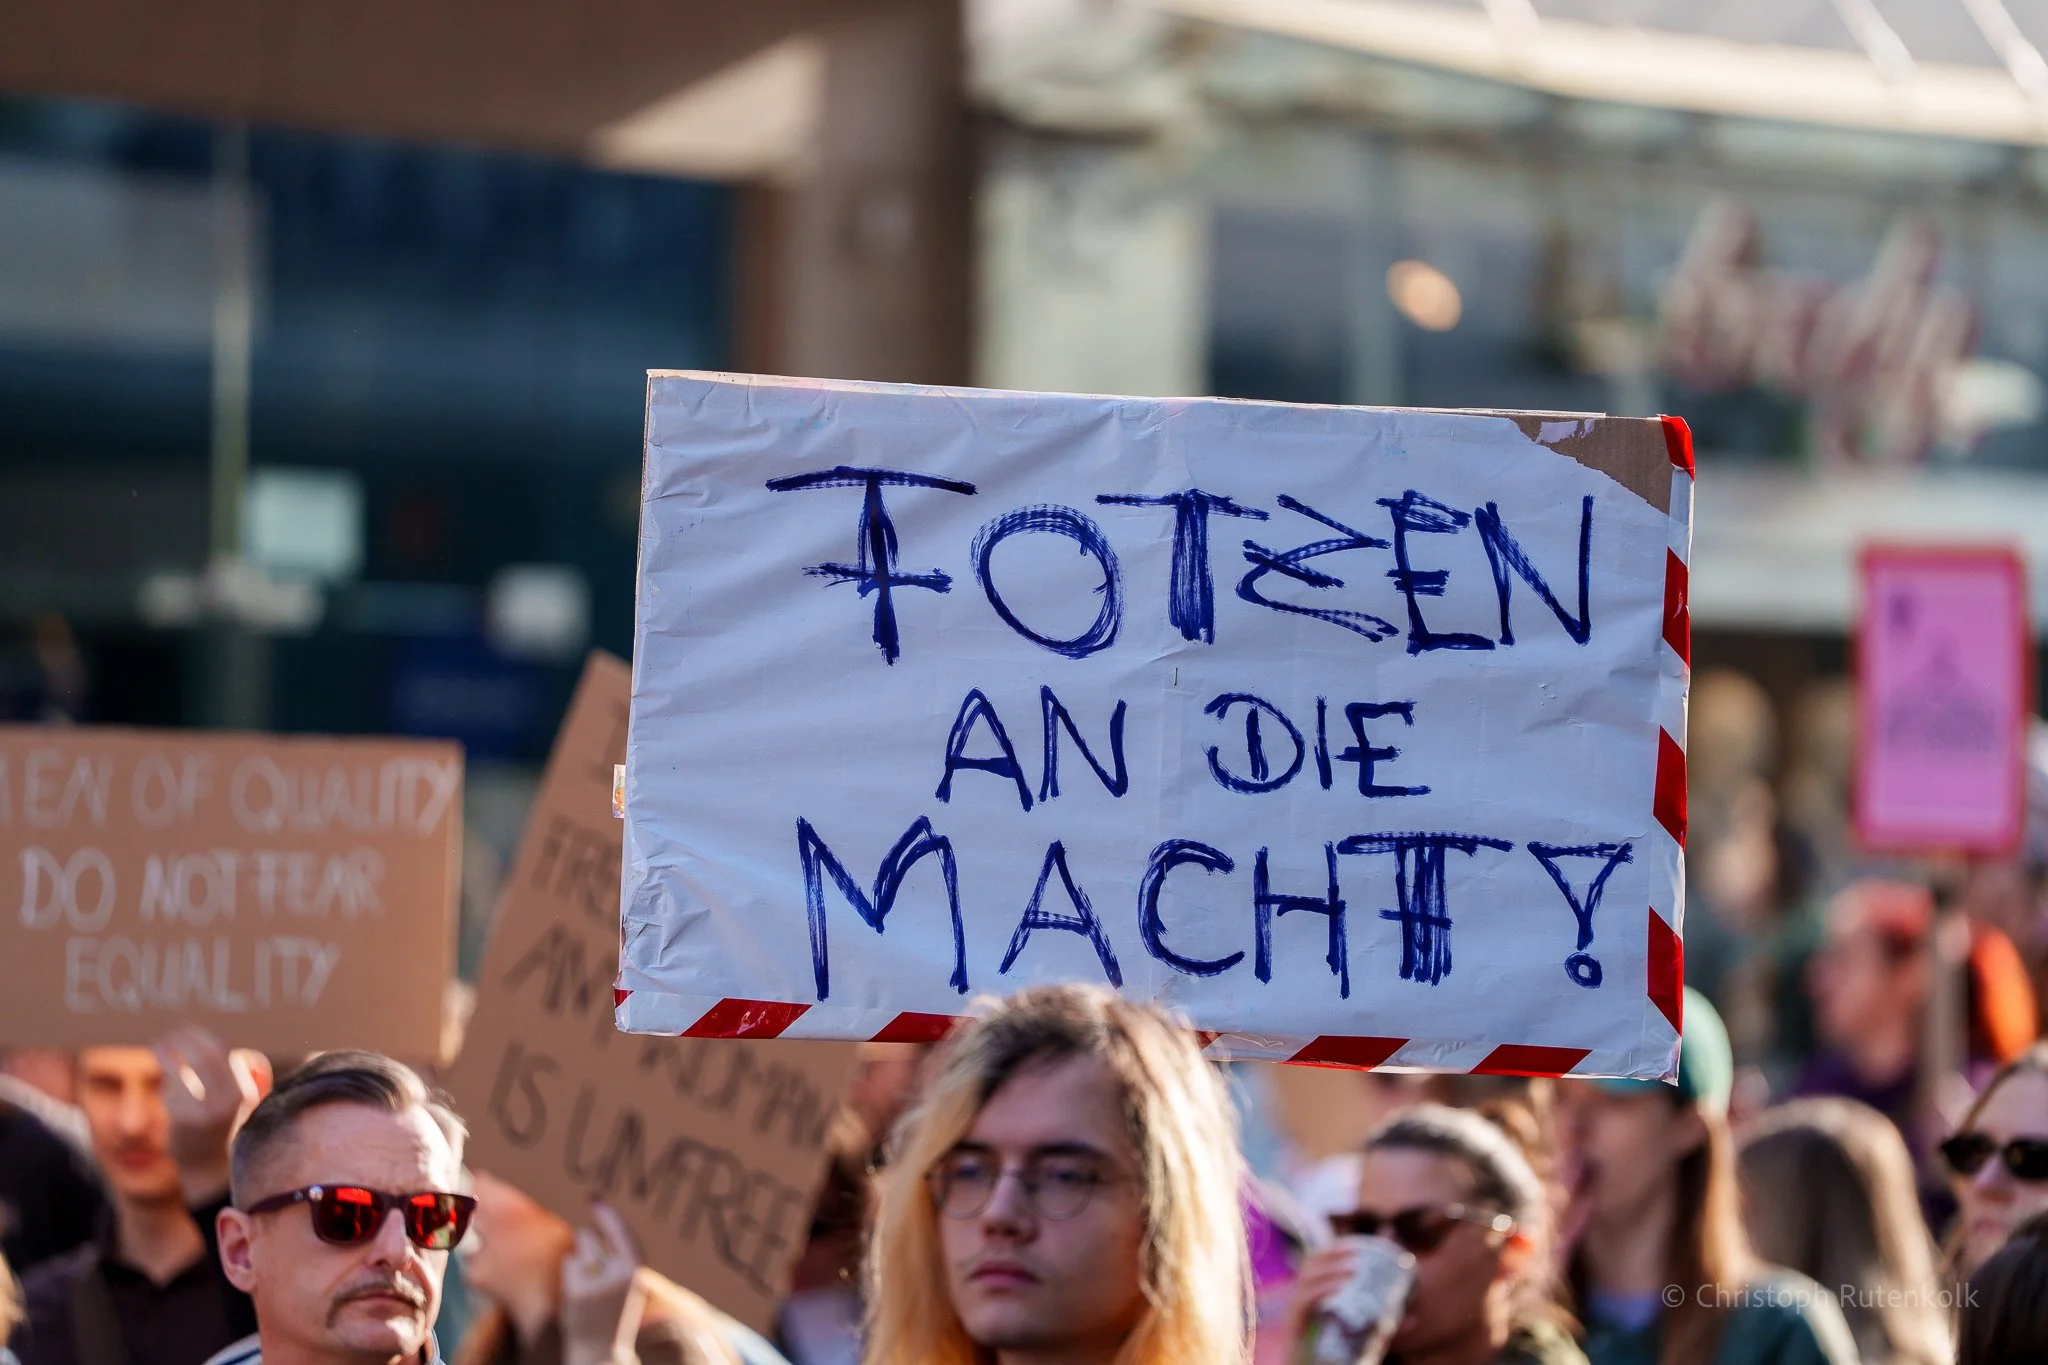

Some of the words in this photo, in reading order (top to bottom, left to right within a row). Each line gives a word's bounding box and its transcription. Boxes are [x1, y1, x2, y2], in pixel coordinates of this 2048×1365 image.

[766, 466, 1594, 665] FOTZEN
[131, 753, 213, 829] OF
[229, 754, 459, 837] QUALITY
[935, 686, 1128, 811] AN
[1204, 692, 1430, 798] DIE
[19, 846, 117, 932] DO
[140, 849, 238, 926] NOT
[251, 846, 386, 922] FEAR
[797, 815, 1634, 1001] MACHT!
[64, 934, 341, 1014] EQUALITY
[487, 1040, 562, 1150] IS
[562, 1079, 803, 1298] UNFREE
